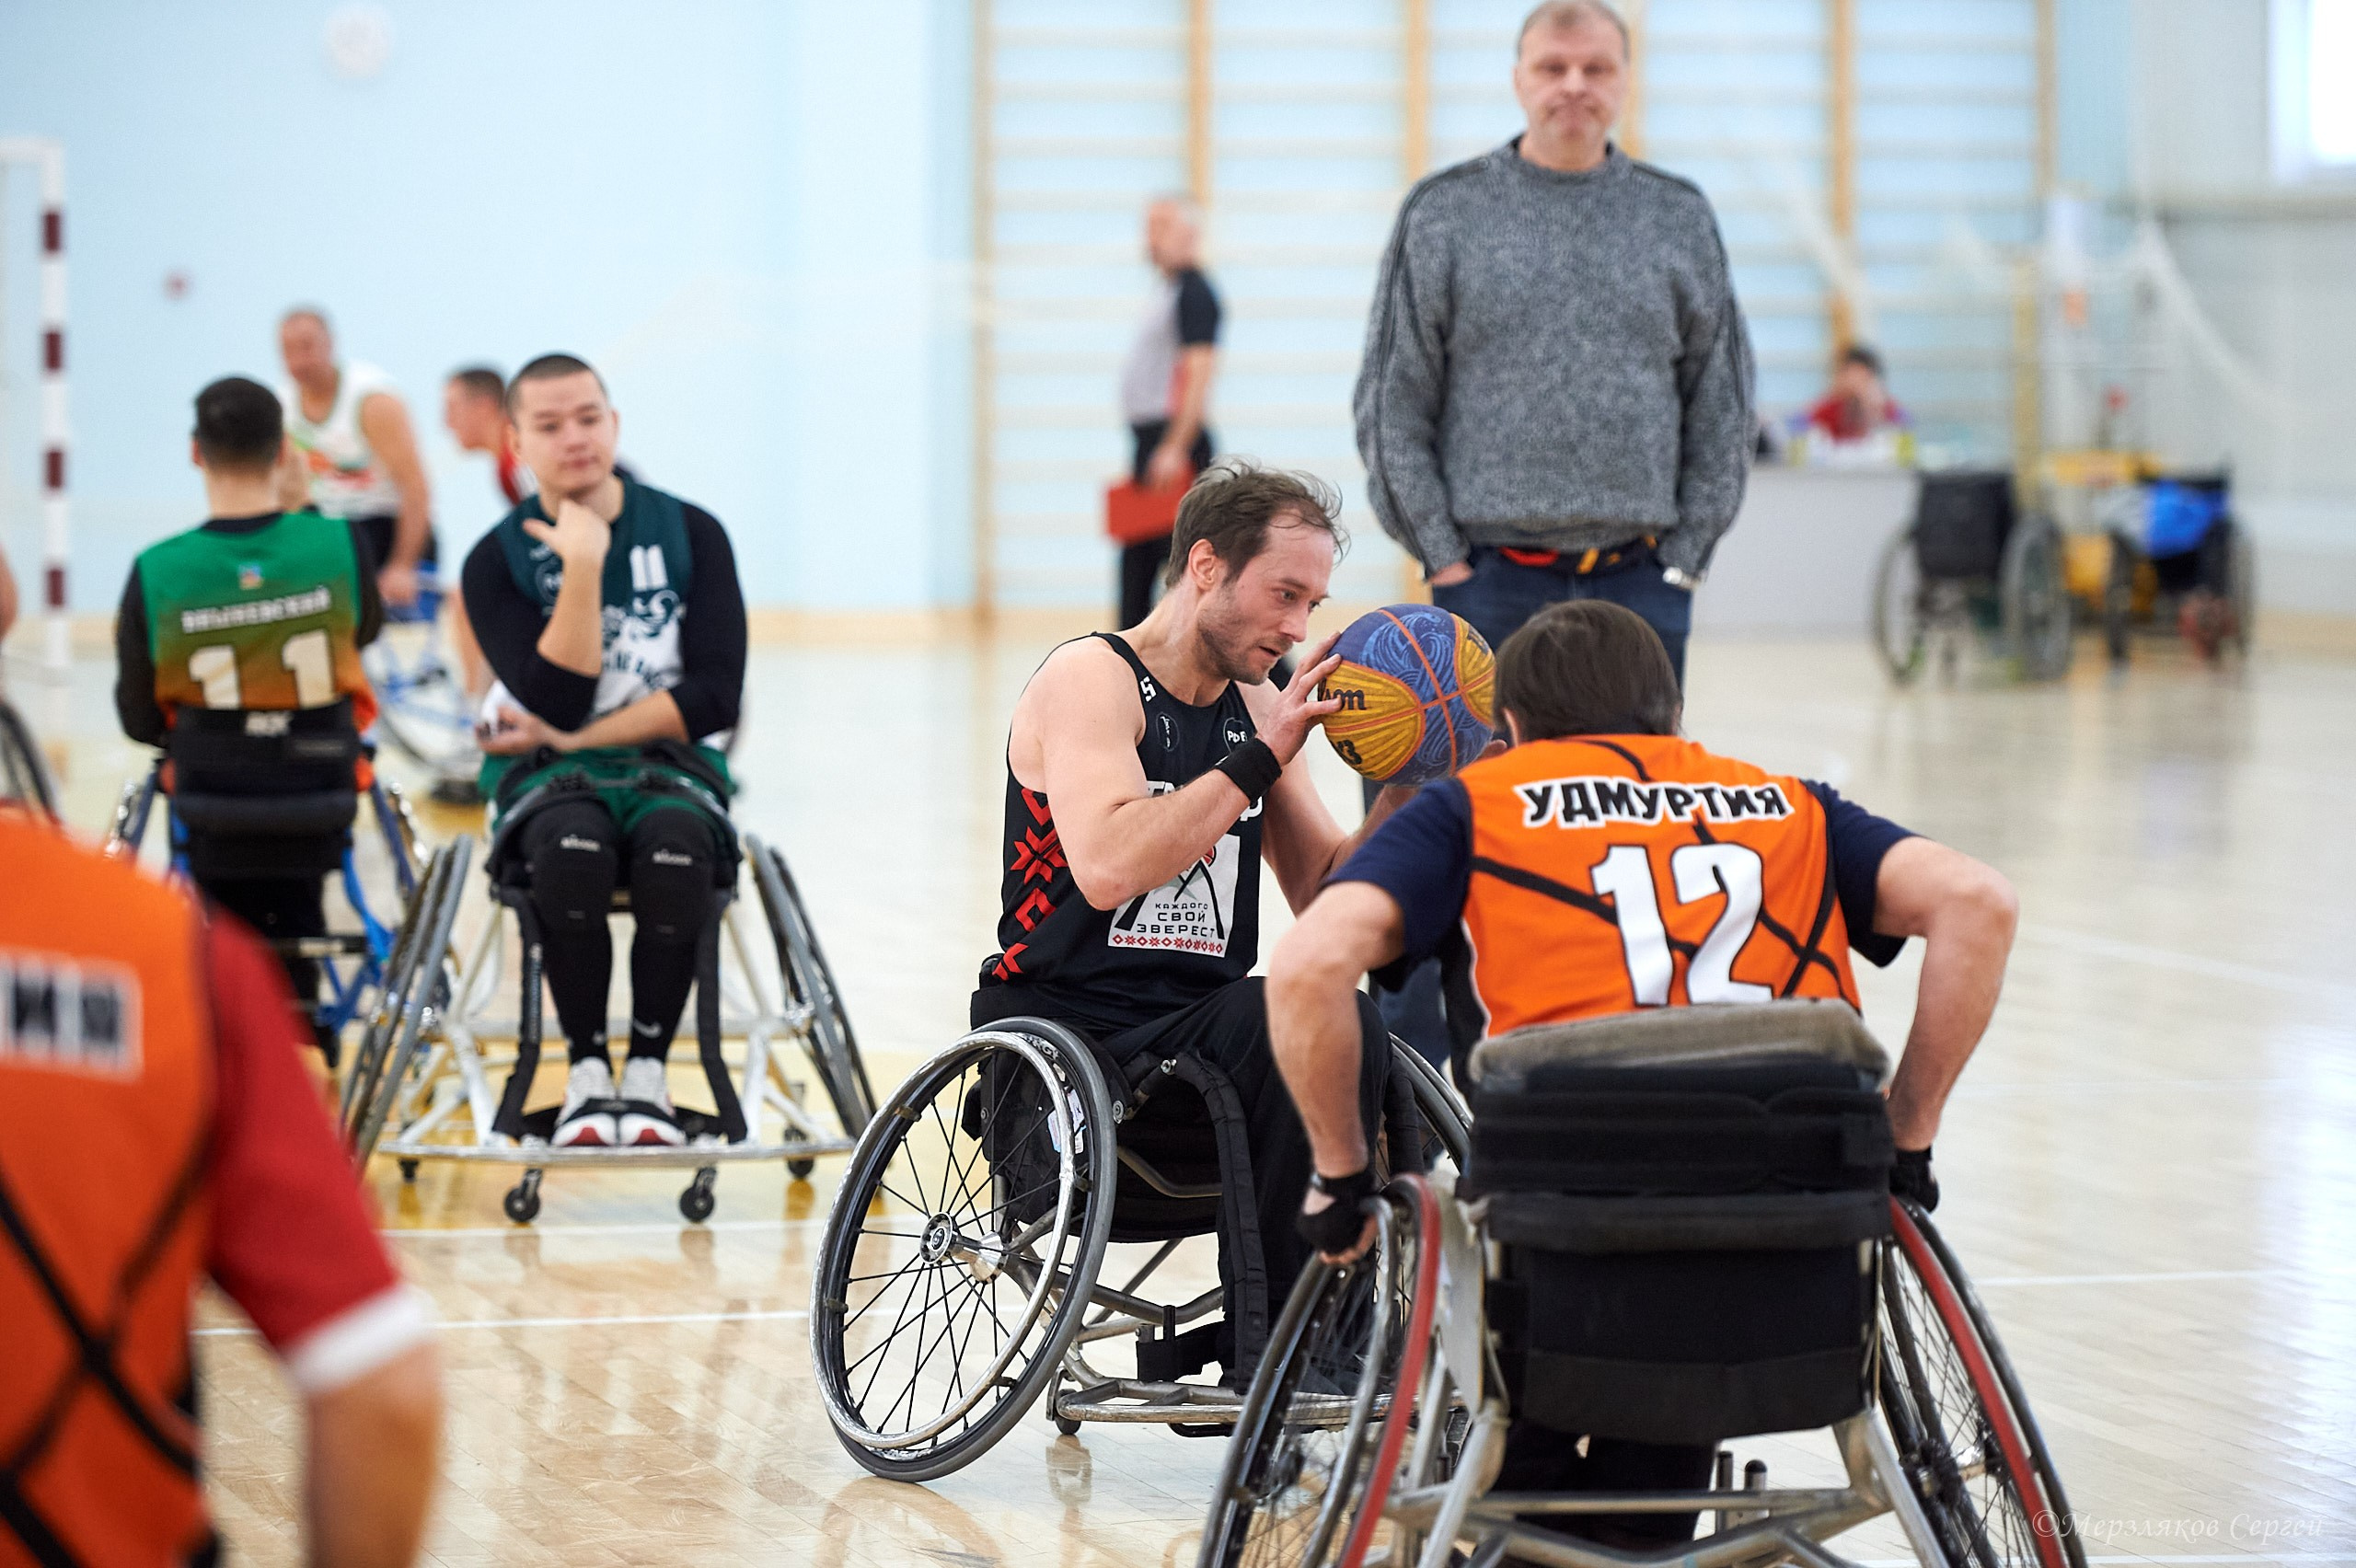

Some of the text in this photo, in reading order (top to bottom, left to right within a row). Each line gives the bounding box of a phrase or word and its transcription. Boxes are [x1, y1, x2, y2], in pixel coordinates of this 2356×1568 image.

[189, 629, 337, 710] 11
[1519, 778, 1790, 824] УДМУРТИЯ
[1157, 910, 1207, 923] СВОЙ
[1589, 841, 1773, 1007] 12
